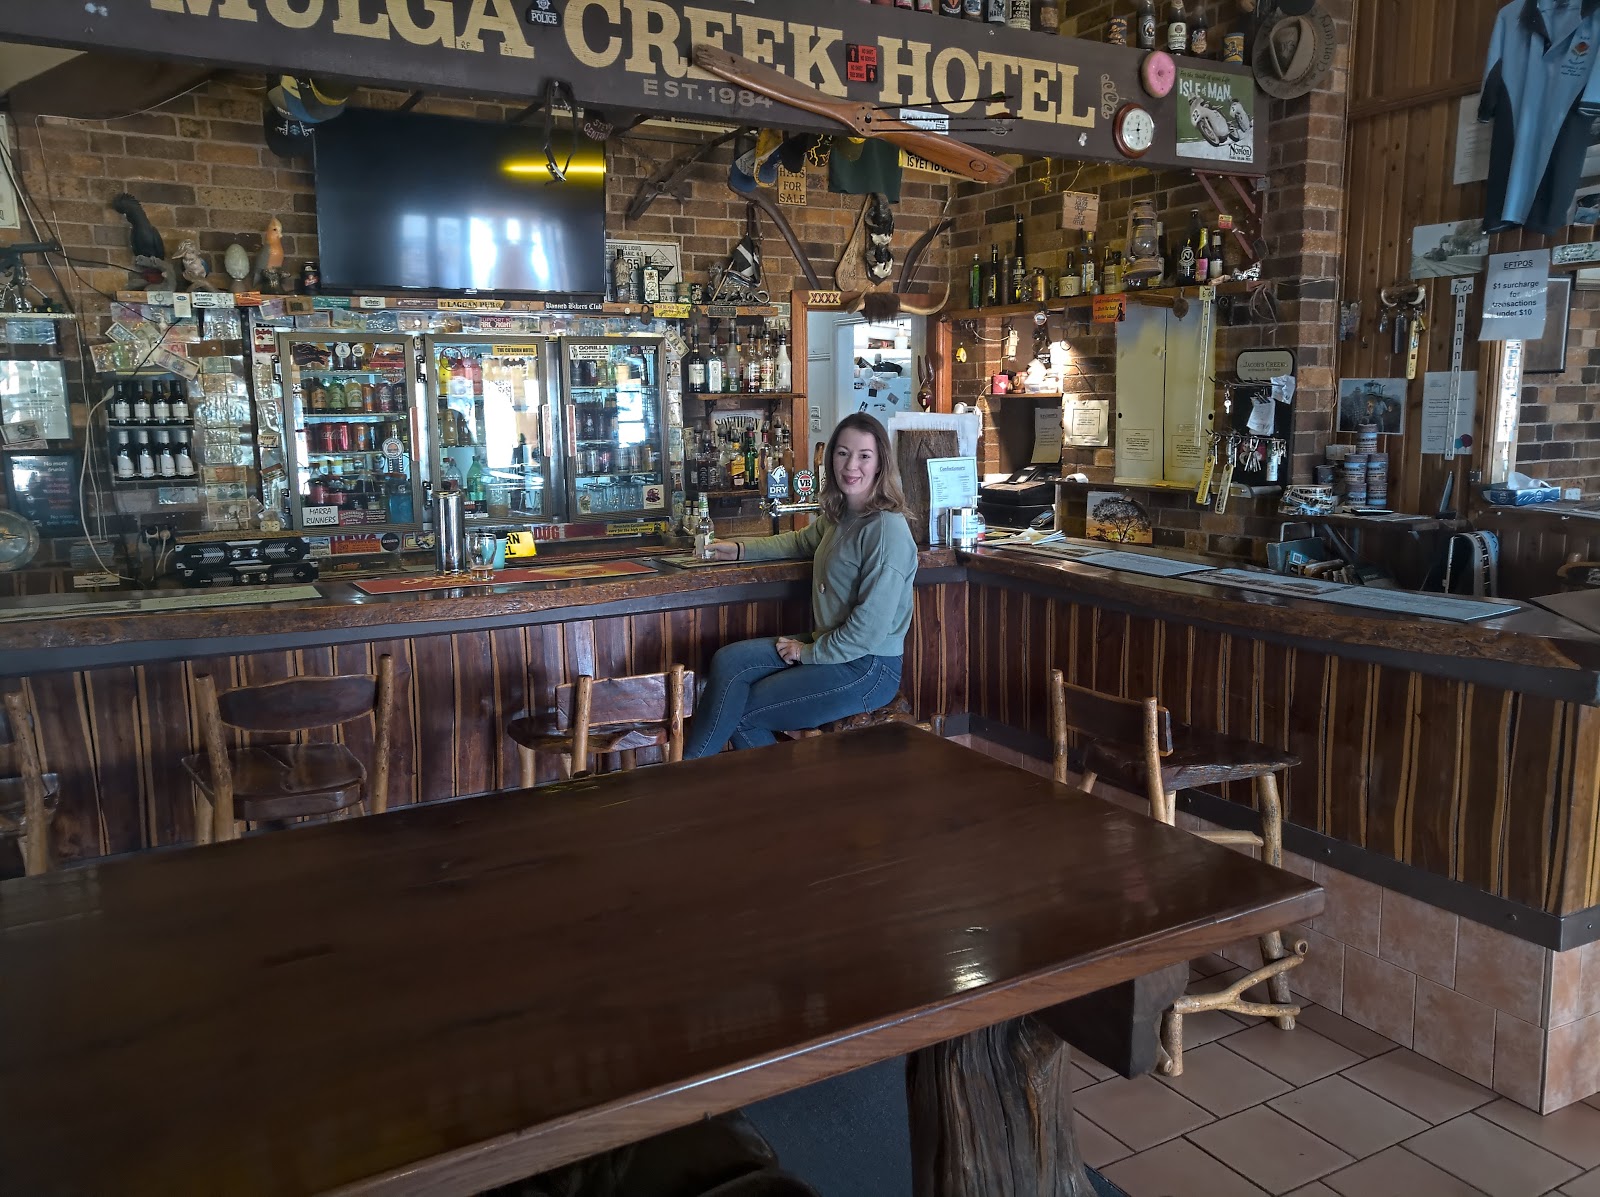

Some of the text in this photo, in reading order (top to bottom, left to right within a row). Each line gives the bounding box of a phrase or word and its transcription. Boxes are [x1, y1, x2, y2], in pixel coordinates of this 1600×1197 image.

[531, 13, 557, 24] POLICE
[564, 0, 848, 98] CREEK
[878, 36, 1097, 128] HOTEL
[1180, 78, 1201, 97] ISLE
[643, 79, 773, 108] EST. 1984
[1230, 144, 1251, 157] Norton
[907, 156, 913, 167] IS
[915, 156, 928, 170] YET
[784, 181, 801, 191] FOR
[779, 193, 806, 203] SALE
[1503, 260, 1533, 268] EFTPOS
[1493, 280, 1539, 290] $1 surcharge
[810, 292, 838, 303] XXXX
[480, 301, 497, 309] PUB
[589, 302, 603, 310] Club
[1492, 299, 1536, 307] transactions
[1519, 309, 1532, 317] $10
[794, 470, 815, 481] VICTORIA
[799, 479, 811, 487] VB
[769, 486, 788, 494] DRY
[796, 488, 815, 497] BITTER
[306, 515, 336, 524] RUNNERS
